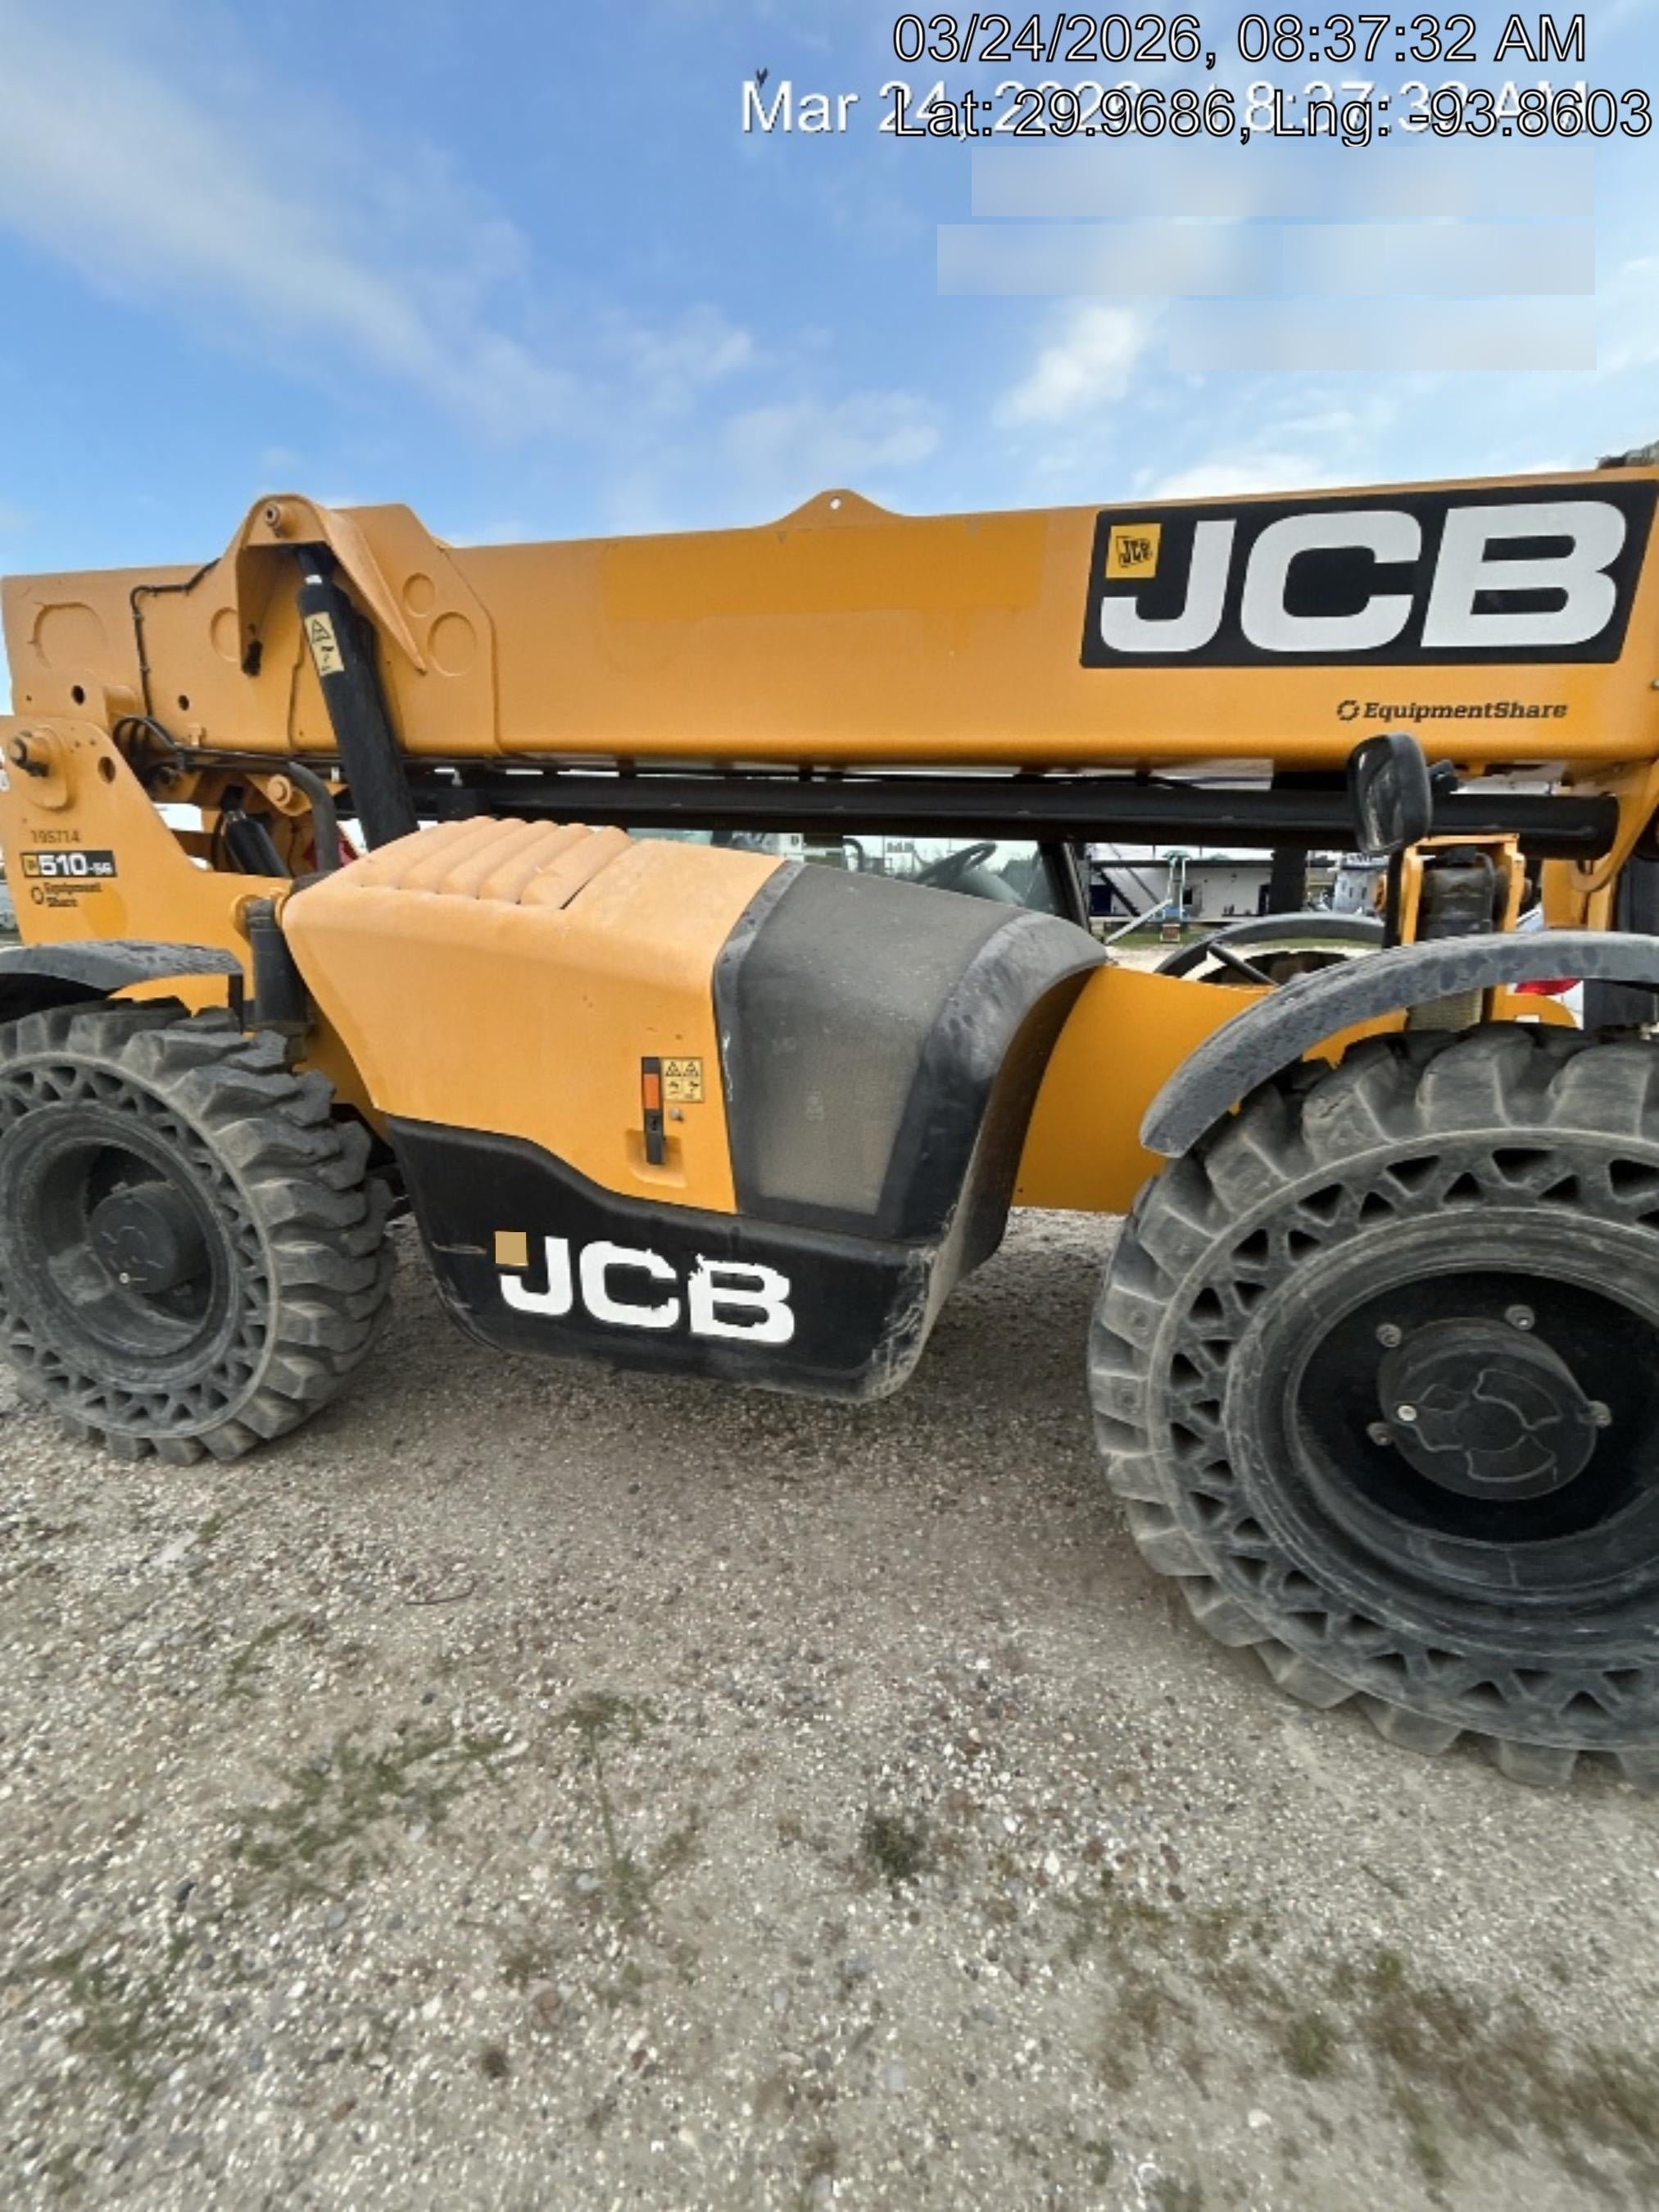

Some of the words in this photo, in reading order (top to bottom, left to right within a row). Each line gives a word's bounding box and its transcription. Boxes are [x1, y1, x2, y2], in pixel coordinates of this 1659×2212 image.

[1101, 501, 1627, 652] JCB
[1362, 701, 1568, 723] EquipmentShare
[499, 1235, 796, 1344] JCB
